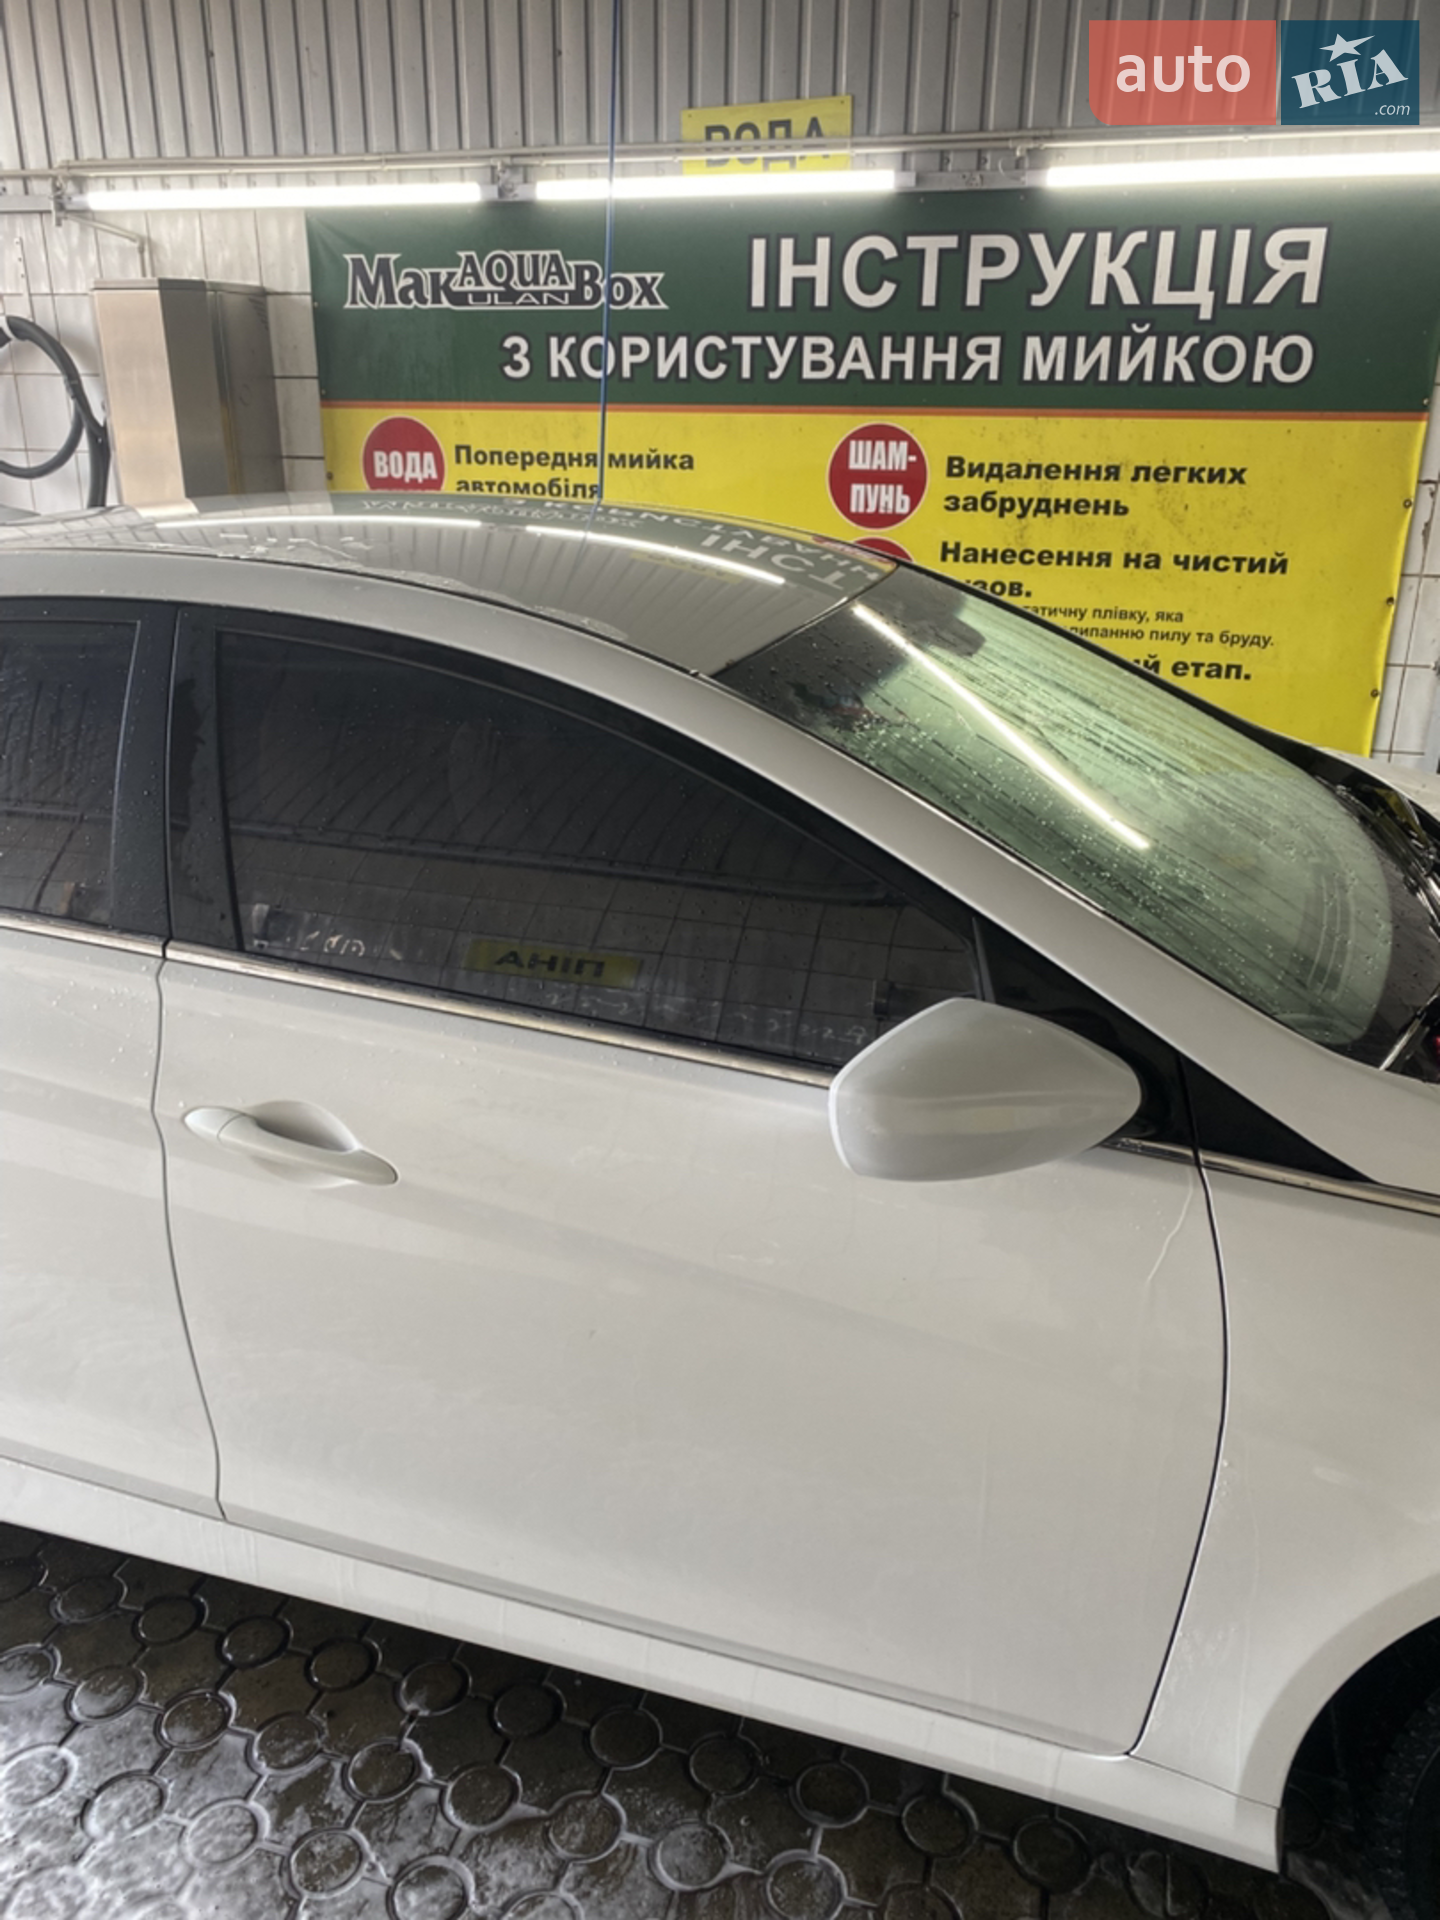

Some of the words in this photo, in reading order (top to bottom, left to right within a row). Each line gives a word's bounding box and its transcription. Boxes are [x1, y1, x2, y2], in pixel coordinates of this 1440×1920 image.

[750, 226, 1329, 320] ІНСТРУКЦІЯ
[502, 335, 531, 379] З
[549, 335, 1001, 383] КОРИСТУВАННЯ
[1022, 324, 1316, 384] МИЙКОЮ
[373, 450, 438, 484] ВОДА
[454, 444, 598, 471] Попередня
[608, 448, 695, 471] мийка
[848, 439, 918, 472] ШАМ-
[945, 455, 1122, 484] Видалення
[1130, 465, 1248, 486] легких
[455, 477, 600, 499] автомобіля
[849, 483, 911, 515] ПУНЬ
[943, 491, 1130, 519] забруднень
[939, 541, 1113, 568] Нанесення
[1122, 551, 1162, 570] на
[1173, 551, 1289, 575] чистий
[964, 579, 1033, 598] зов.
[1092, 606, 1150, 624] плівку,
[1155, 611, 1184, 623] яка
[1149, 629, 1191, 646] пилу
[1196, 632, 1214, 643] та
[1219, 630, 1275, 650] бруду.
[1134, 653, 1161, 675] й
[1171, 660, 1252, 681] етап.
